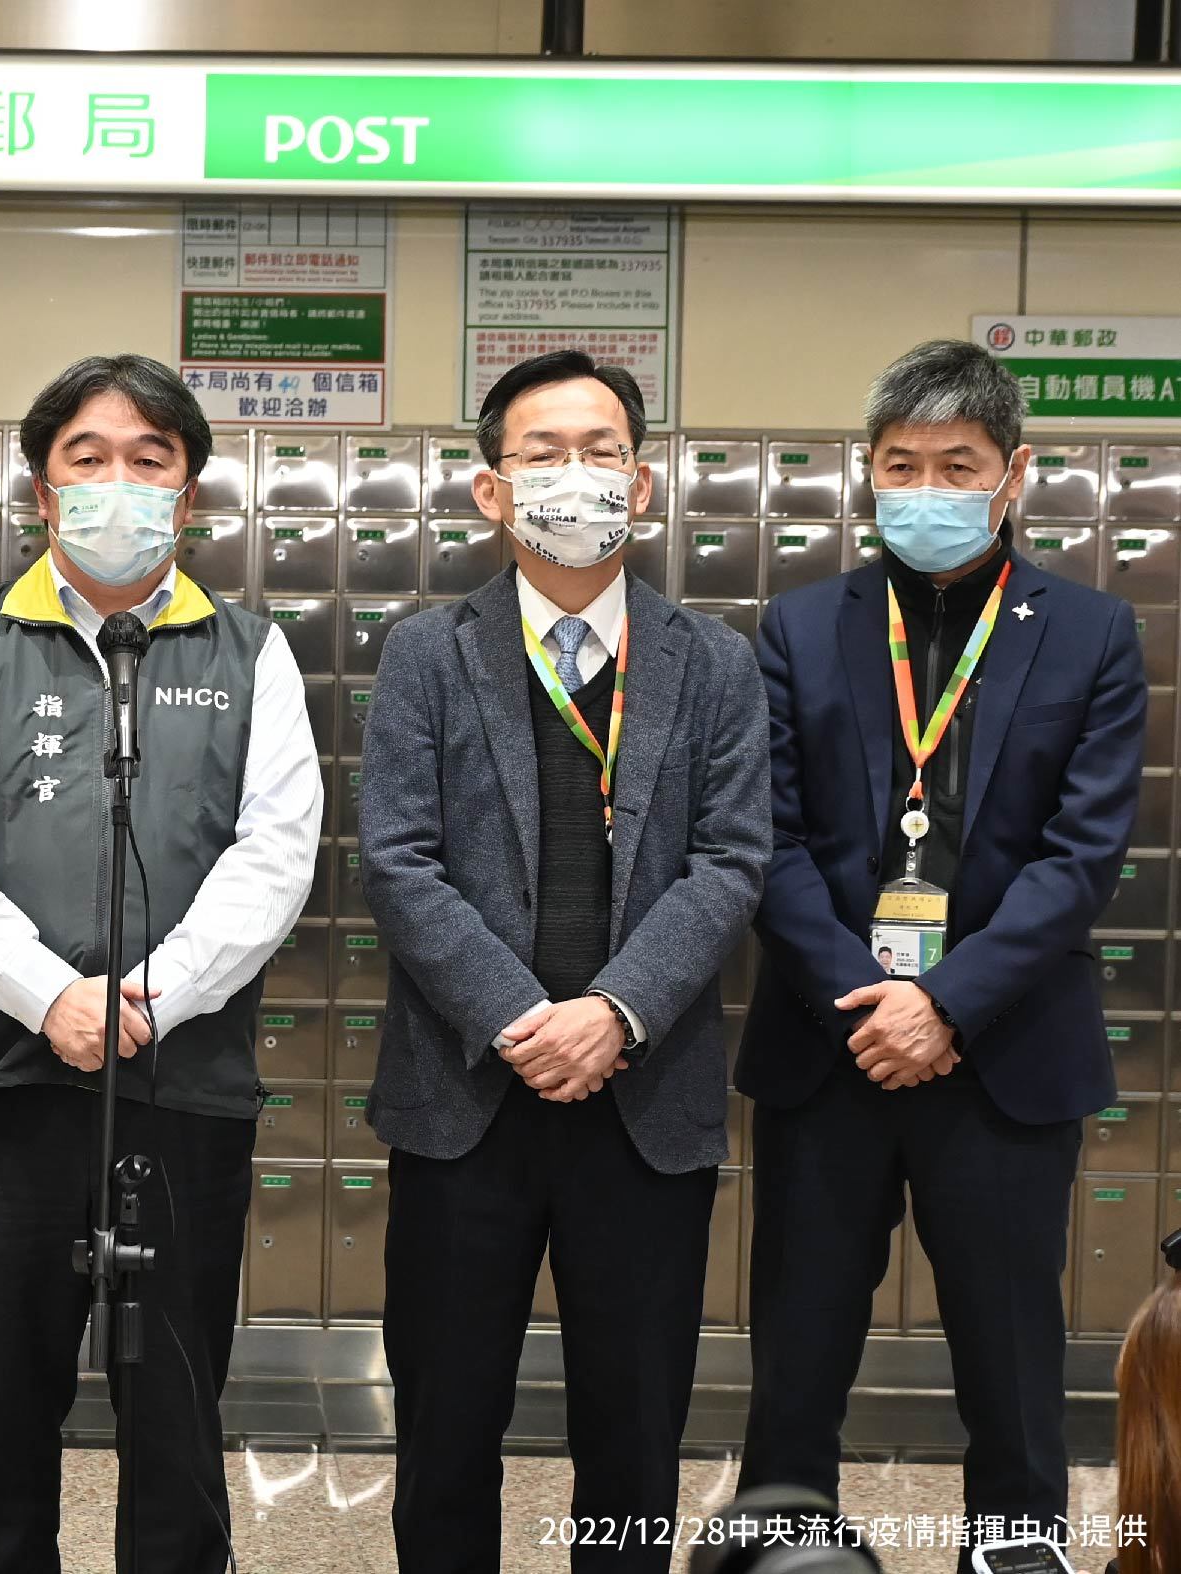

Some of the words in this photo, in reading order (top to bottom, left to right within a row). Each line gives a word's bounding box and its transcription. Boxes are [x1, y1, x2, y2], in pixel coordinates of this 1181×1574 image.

[264, 115, 430, 165] POST
[540, 235, 582, 247] 337935
[1025, 328, 1117, 348] 中華郵政
[186, 371, 274, 393] 本局尚有
[312, 372, 378, 393] 個信箱
[239, 397, 327, 418] 歡迎洽辦
[155, 686, 230, 711] NHCC
[32, 693, 64, 803] 指揮官
[927, 947, 937, 962] 7
